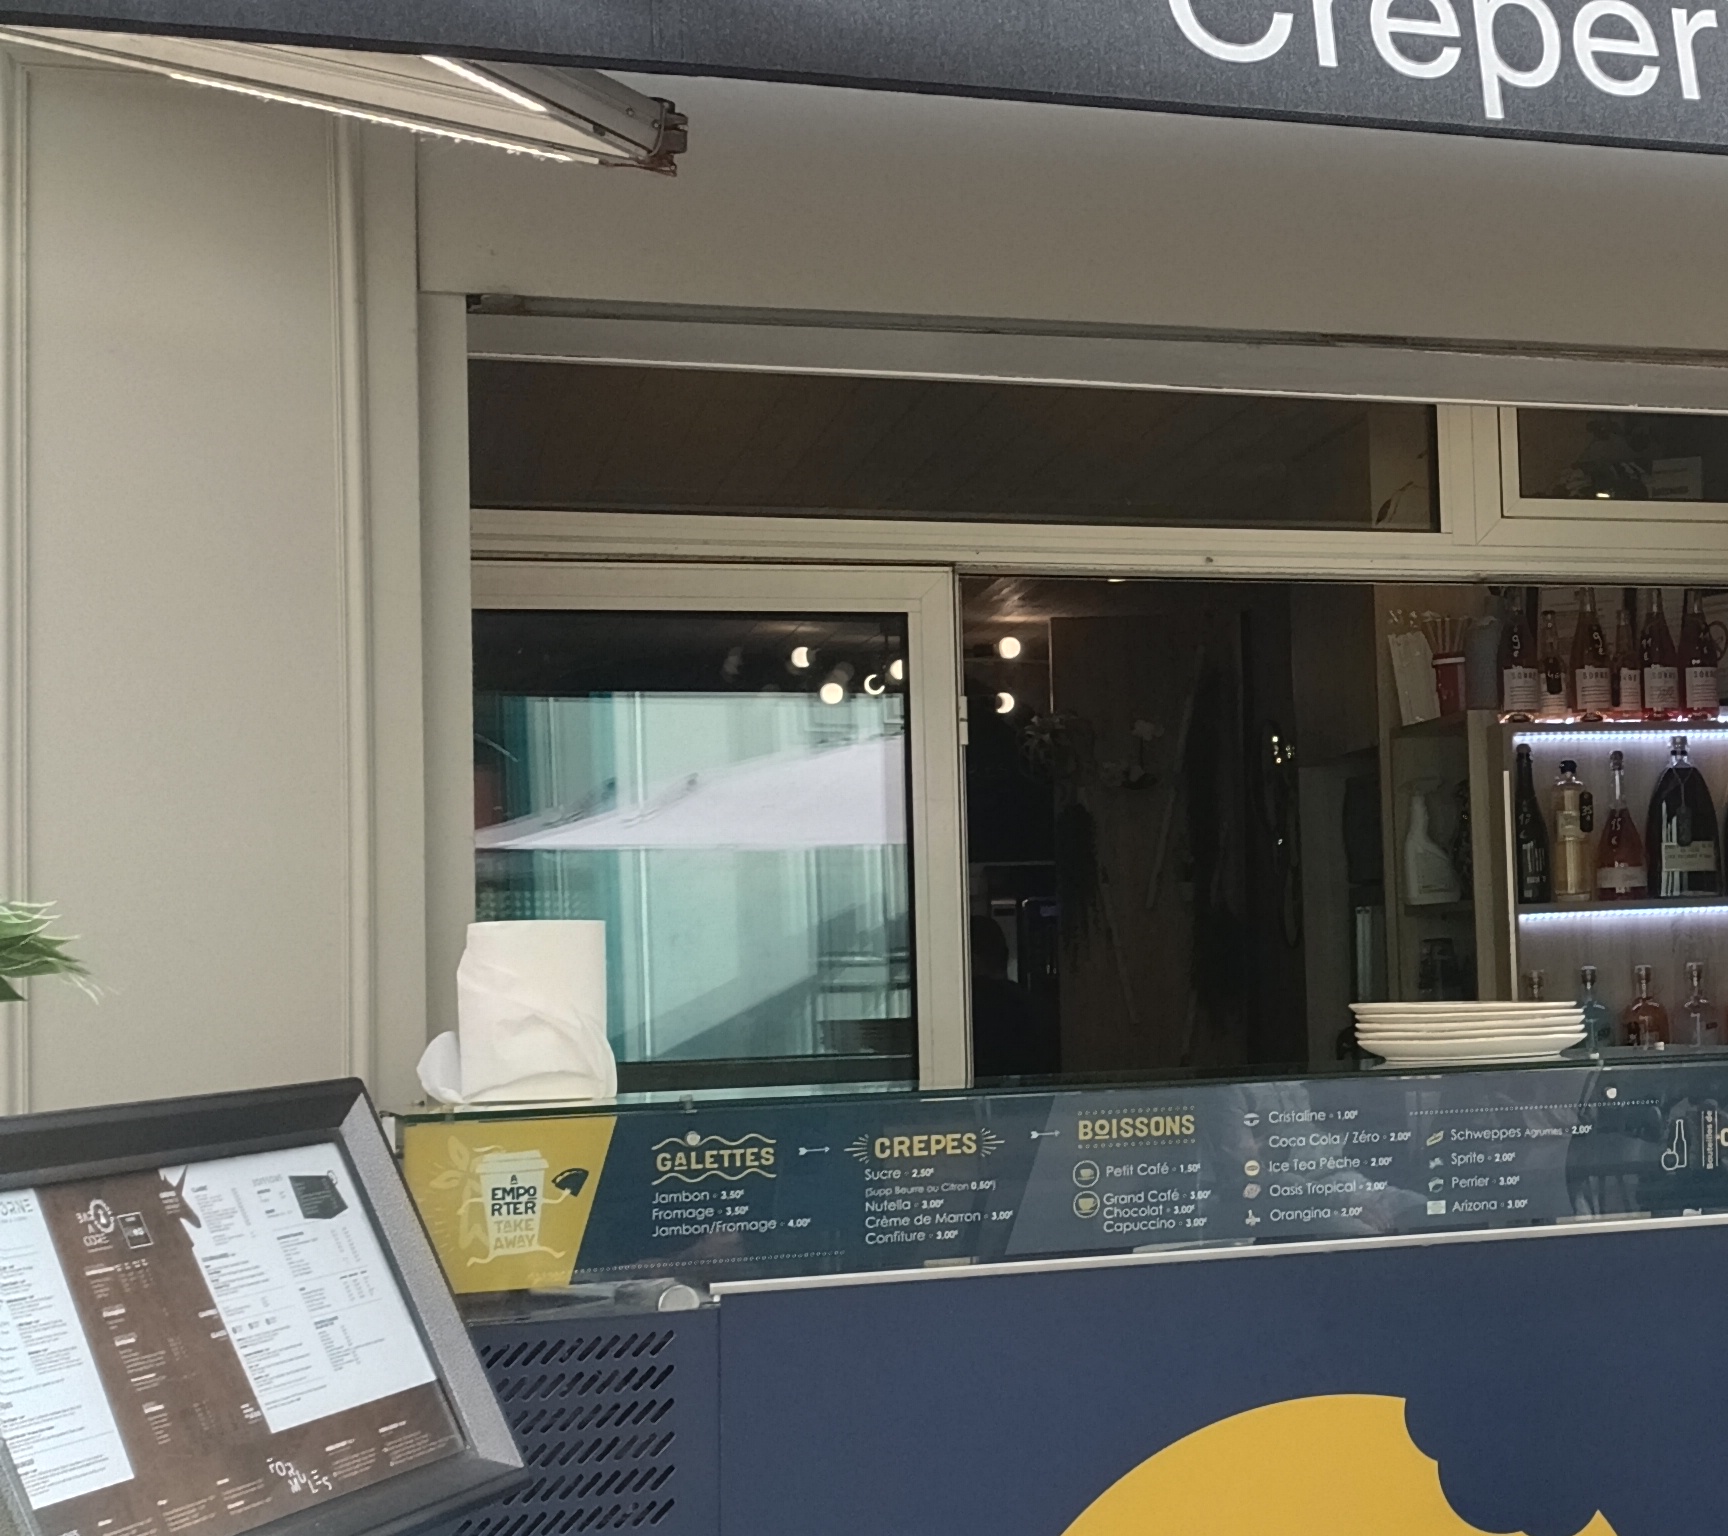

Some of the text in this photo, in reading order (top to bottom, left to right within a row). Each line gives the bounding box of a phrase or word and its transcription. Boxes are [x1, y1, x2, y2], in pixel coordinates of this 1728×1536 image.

[1268, 1110, 1326, 1124] Cristaline
[1078, 1114, 1195, 1141] BOISSONS
[1450, 1127, 1522, 1142] Schweppes
[874, 1132, 978, 1159] CREPES
[1268, 1134, 1306, 1148] Coca
[1309, 1132, 1340, 1146] Cola
[1352, 1129, 1380, 1144] Zéro
[656, 1147, 775, 1172] GALETTES
[1268, 1160, 1290, 1173] Ice
[1293, 1158, 1316, 1172] Tea
[1319, 1155, 1361, 1170] Pêche
[1450, 1152, 1485, 1167] Sprite
[864, 1167, 902, 1181] Sucre
[1105, 1164, 1134, 1178] Petit
[1137, 1161, 1169, 1176] Café
[1269, 1183, 1304, 1197] Oasis
[1306, 1179, 1357, 1196] Tropical
[1451, 1175, 1489, 1189] Perrier
[490, 1185, 538, 1202] EMPO
[652, 1189, 710, 1205] Jambon
[1102, 1190, 1145, 1206] Grand
[1147, 1188, 1180, 1203] Café
[490, 1200, 537, 1216] RTER
[864, 1199, 912, 1212] Nutella
[1102, 1204, 1164, 1219] Chocolat
[1452, 1199, 1498, 1213] Arizona
[652, 1207, 715, 1221] Fromage
[864, 1214, 911, 1229] Crème
[913, 1213, 932, 1226] de
[935, 1211, 981, 1225] Marron
[1269, 1206, 1331, 1222] Orangina
[493, 1218, 535, 1234] TAKE
[652, 1217, 777, 1238] Jambon/Fromage
[1103, 1218, 1176, 1234] Capuccino
[493, 1234, 536, 1251] AWAY
[864, 1230, 926, 1245] Confiture
